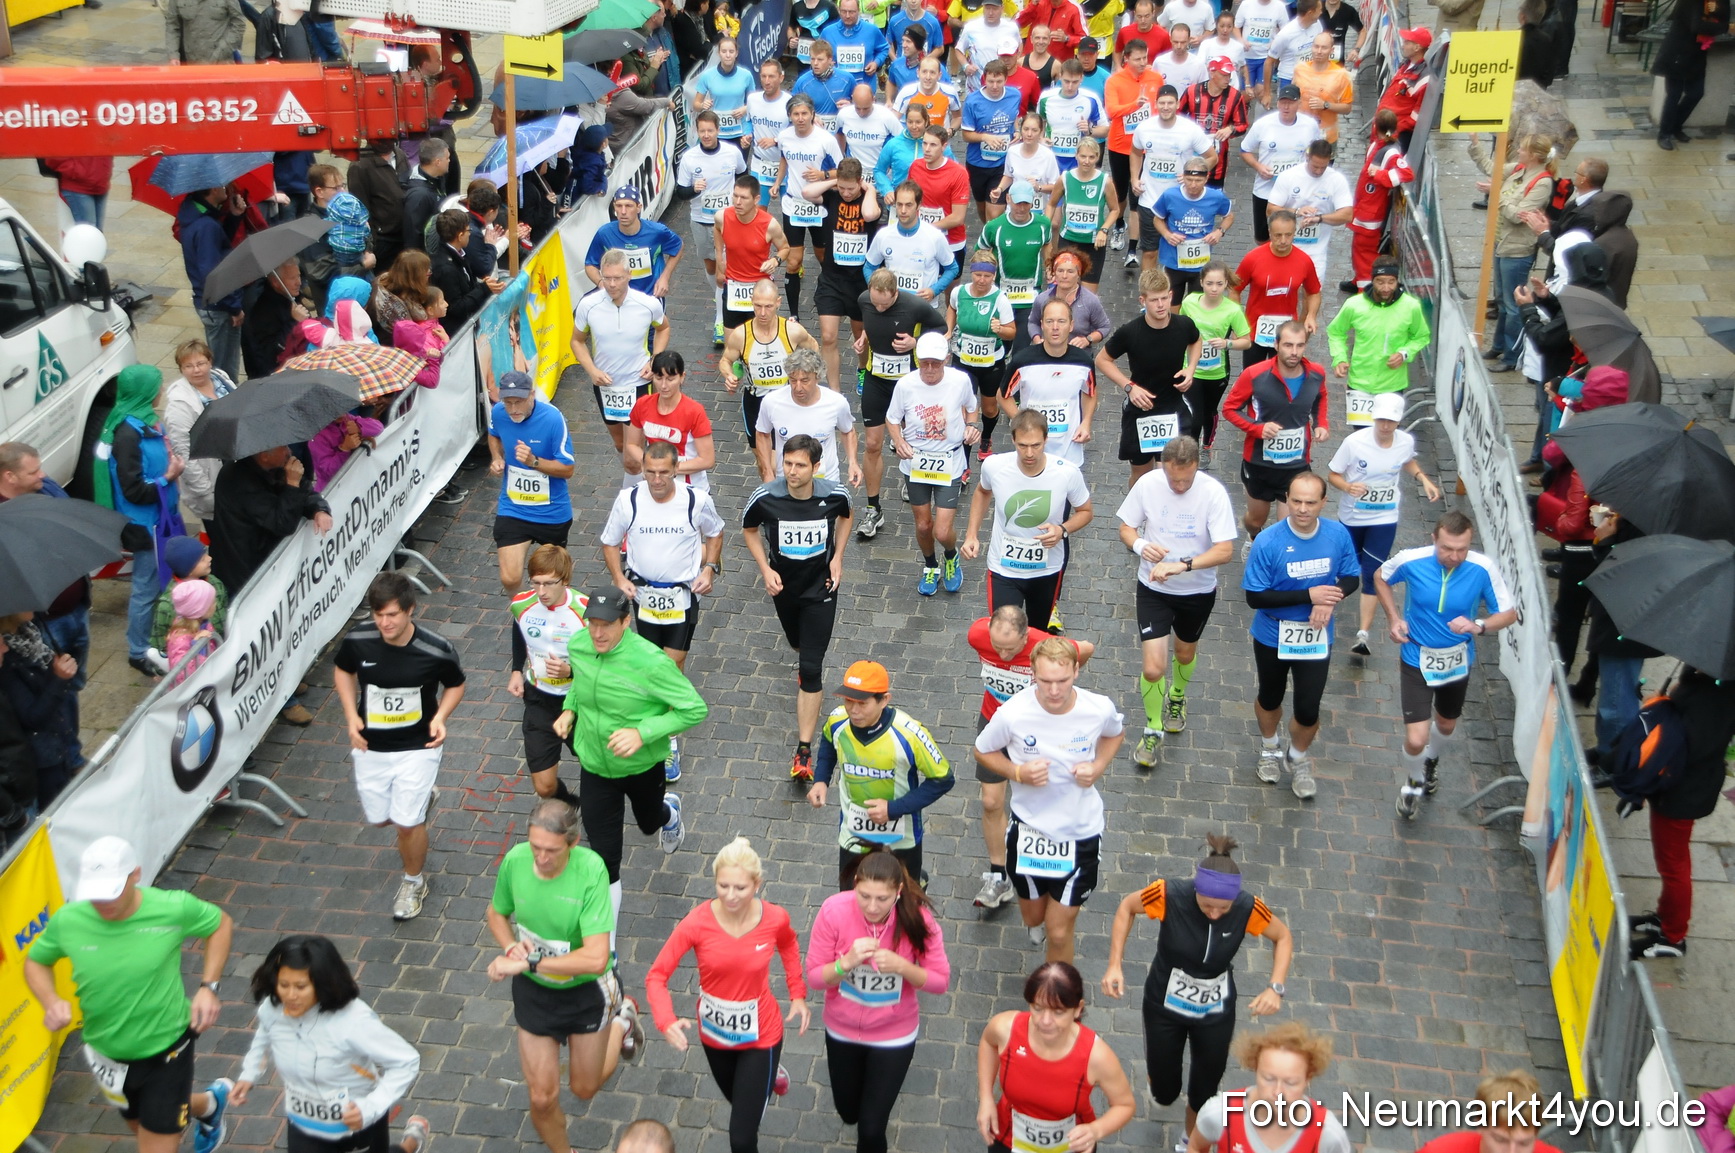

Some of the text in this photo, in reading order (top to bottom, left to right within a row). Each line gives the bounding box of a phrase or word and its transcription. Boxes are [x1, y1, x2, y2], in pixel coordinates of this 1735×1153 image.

[1250, 28, 1270, 38] 2435
[840, 53, 862, 63] 2969
[1450, 58, 1514, 78] Jugend-
[1465, 78, 1496, 93] lauf
[98, 102, 178, 126] 09181
[187, 99, 258, 122] 6352
[1126, 110, 1150, 124] 2639
[847, 130, 880, 142] Gothaer
[1054, 136, 1078, 147] 2799
[786, 150, 818, 162] Gothaer
[762, 166, 779, 176] 212
[1150, 162, 1176, 172] 2492
[704, 196, 730, 209] 2754
[794, 204, 820, 216] 2599
[1068, 210, 1095, 222] 2569
[1294, 227, 1316, 238] 491
[836, 241, 864, 254] 2072
[1187, 246, 1200, 258] 66
[629, 257, 643, 269] 81
[898, 276, 919, 290] 085
[967, 343, 988, 356] 305
[758, 365, 783, 379] 369
[880, 361, 902, 374] 121
[604, 394, 632, 408] 2934
[1352, 400, 1374, 412] 572
[1142, 424, 1174, 439] 2967
[1267, 436, 1301, 451] 2502
[920, 458, 945, 472] 272
[514, 478, 540, 493] 406
[1360, 489, 1394, 502] 2879
[784, 530, 822, 545] 3141
[1004, 544, 1044, 562] 2749
[1286, 558, 1331, 575] HUBER
[648, 596, 676, 610] 383
[234, 660, 285, 731] Wenige
[344, 534, 372, 580] Mehr
[1284, 628, 1322, 644] 2767
[232, 600, 283, 696] BMW
[1426, 652, 1462, 670] 2579
[984, 676, 1024, 695] 2533
[384, 696, 404, 712] 62
[904, 720, 943, 764] BOCK
[843, 763, 896, 780] BOCK
[853, 816, 898, 833] 3087
[1022, 835, 1070, 857] 2650
[1028, 858, 1062, 870] Jonathan
[1174, 980, 1222, 1004] 2263
[704, 1005, 751, 1032] 2649
[291, 1097, 342, 1121] 3068
[1025, 1126, 1064, 1146] 559
